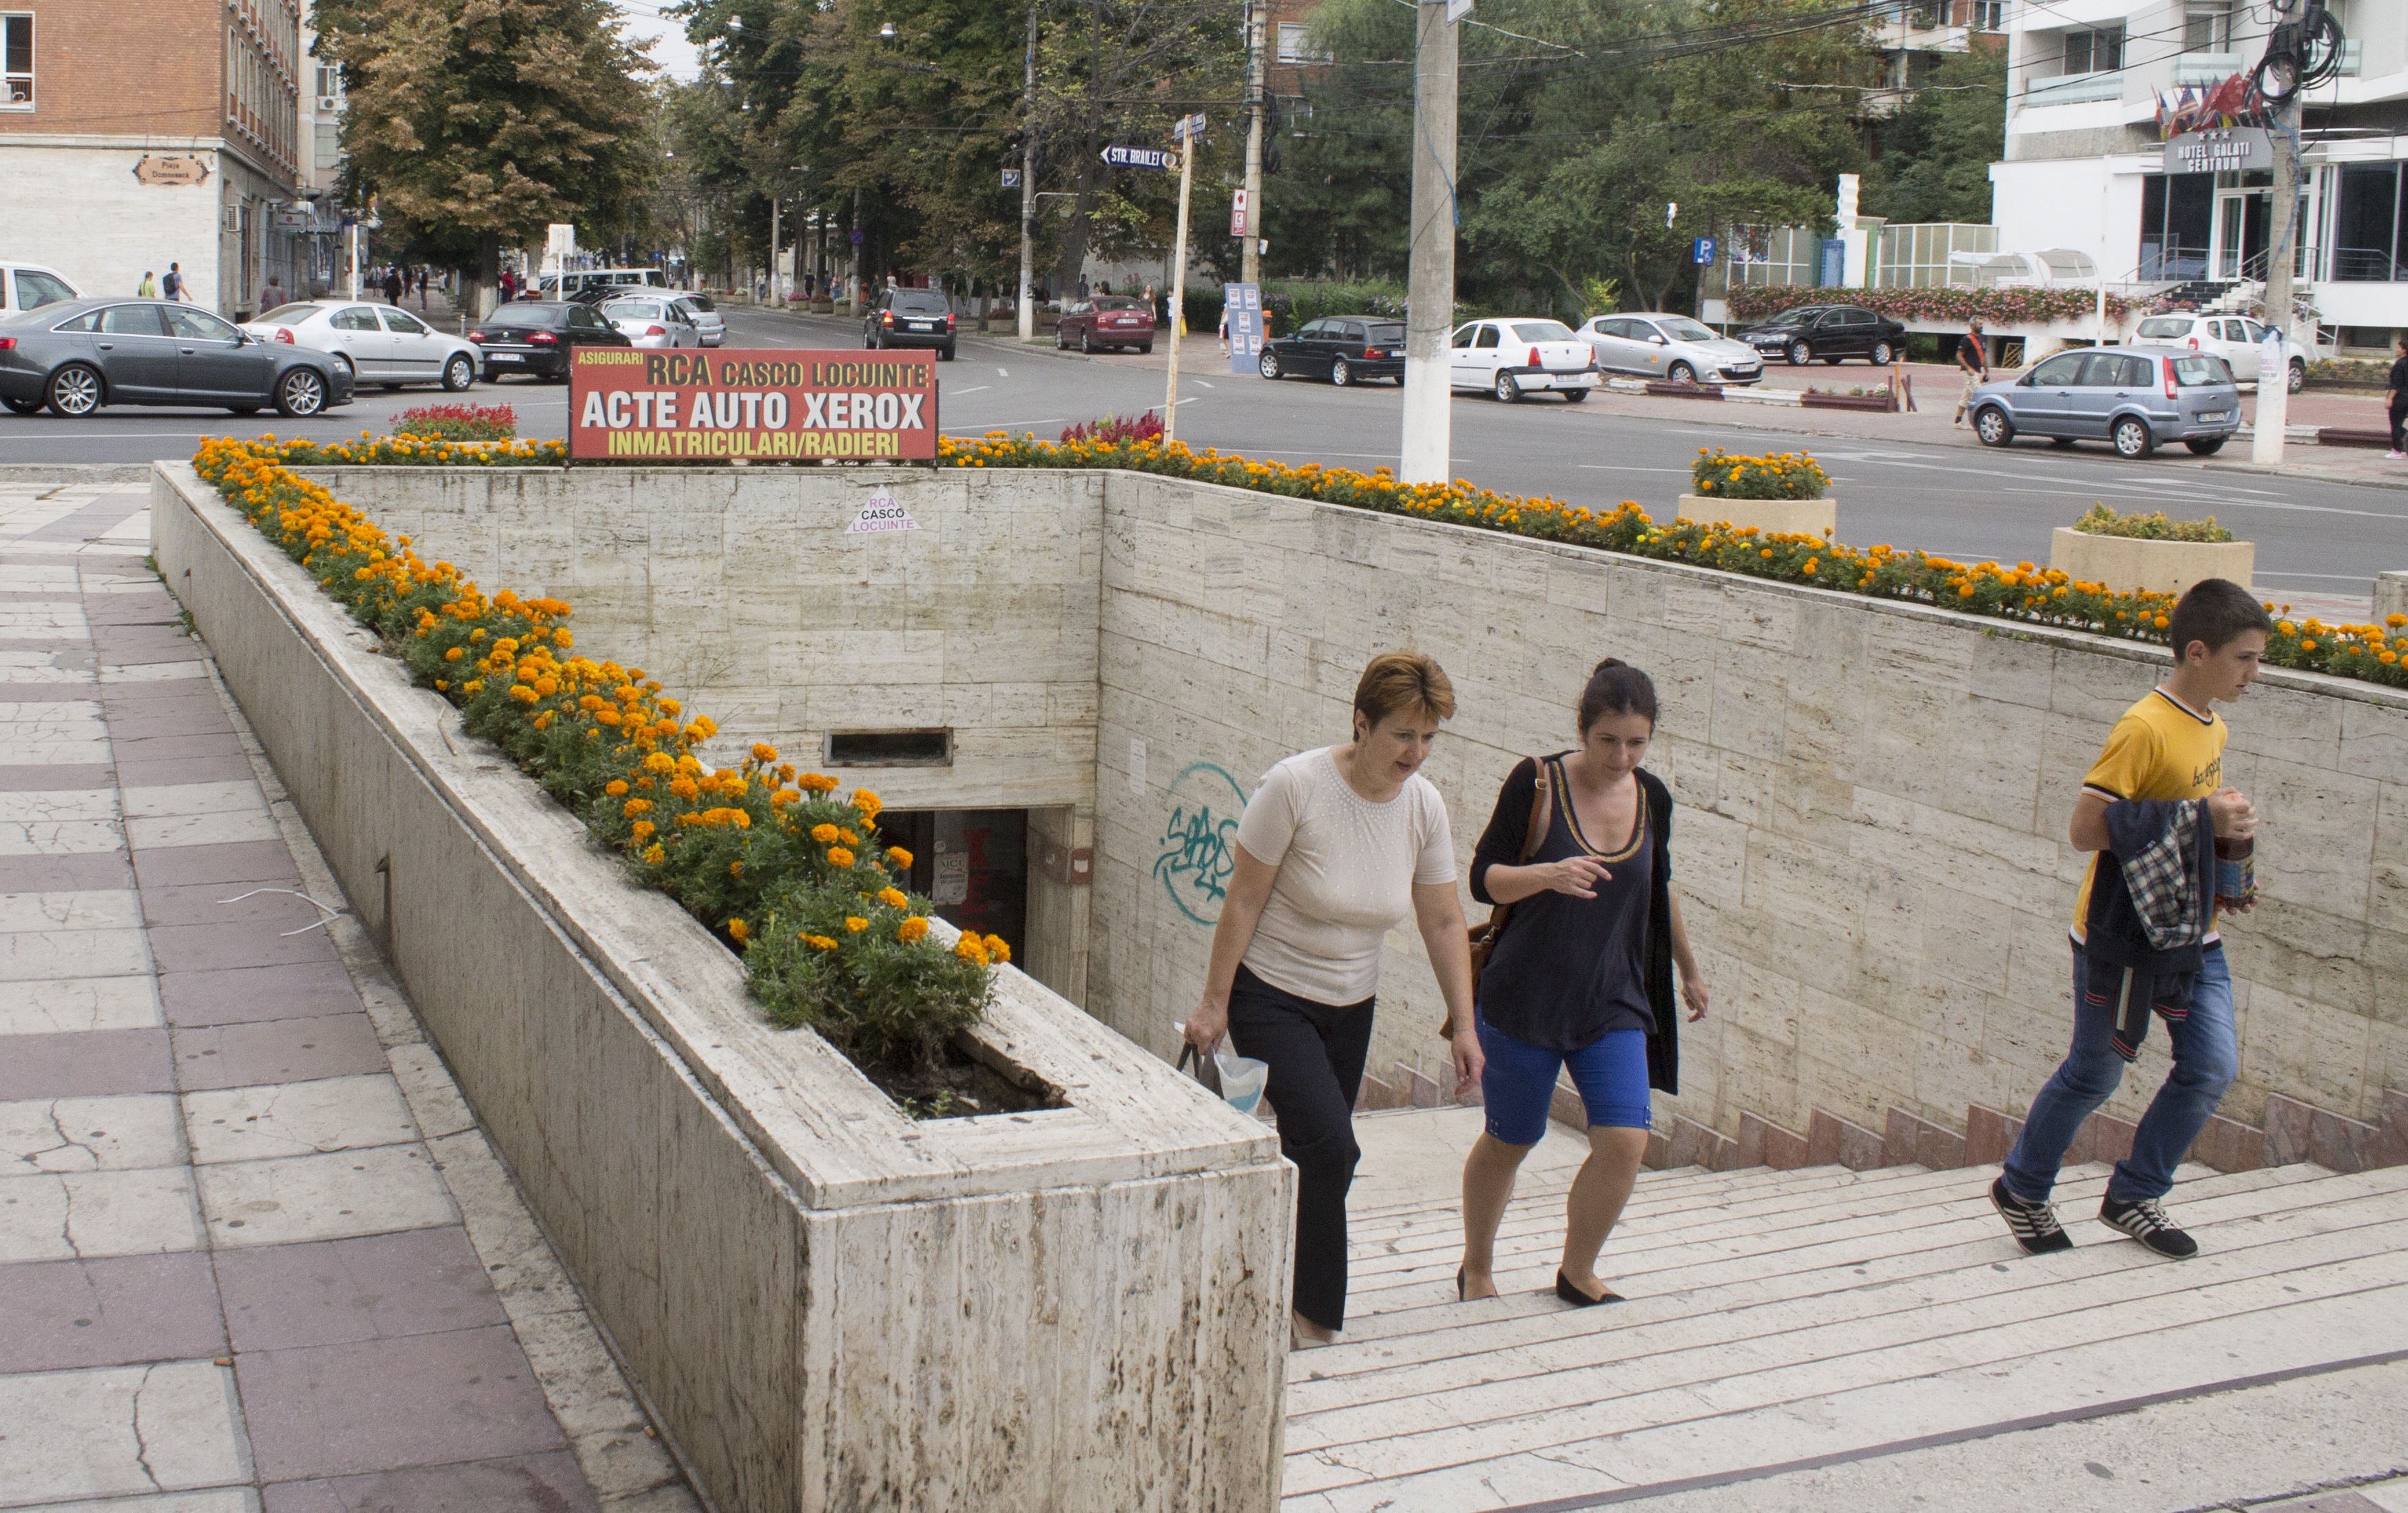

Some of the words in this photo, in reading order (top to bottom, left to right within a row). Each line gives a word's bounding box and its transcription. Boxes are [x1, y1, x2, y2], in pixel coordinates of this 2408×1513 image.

[1111, 147, 1128, 163] STR.
[2178, 145, 2208, 159] HOTEL
[2214, 142, 2251, 157] GALATI
[2188, 156, 2241, 172] CENTRUM
[1700, 240, 1712, 255] P
[579, 352, 644, 364] ASIGURARI
[646, 354, 713, 386] RCA
[721, 362, 804, 387] CASCO
[812, 362, 929, 388] LOCUINTE
[581, 391, 680, 429] ACTE
[689, 391, 790, 429] AUTO
[802, 392, 927, 430] XEROX
[608, 431, 900, 458] INMATRICULARI/RADIERI
[869, 497, 895, 508] RCA
[861, 508, 905, 520] CASCO
[853, 519, 915, 533] LOCUINTE
